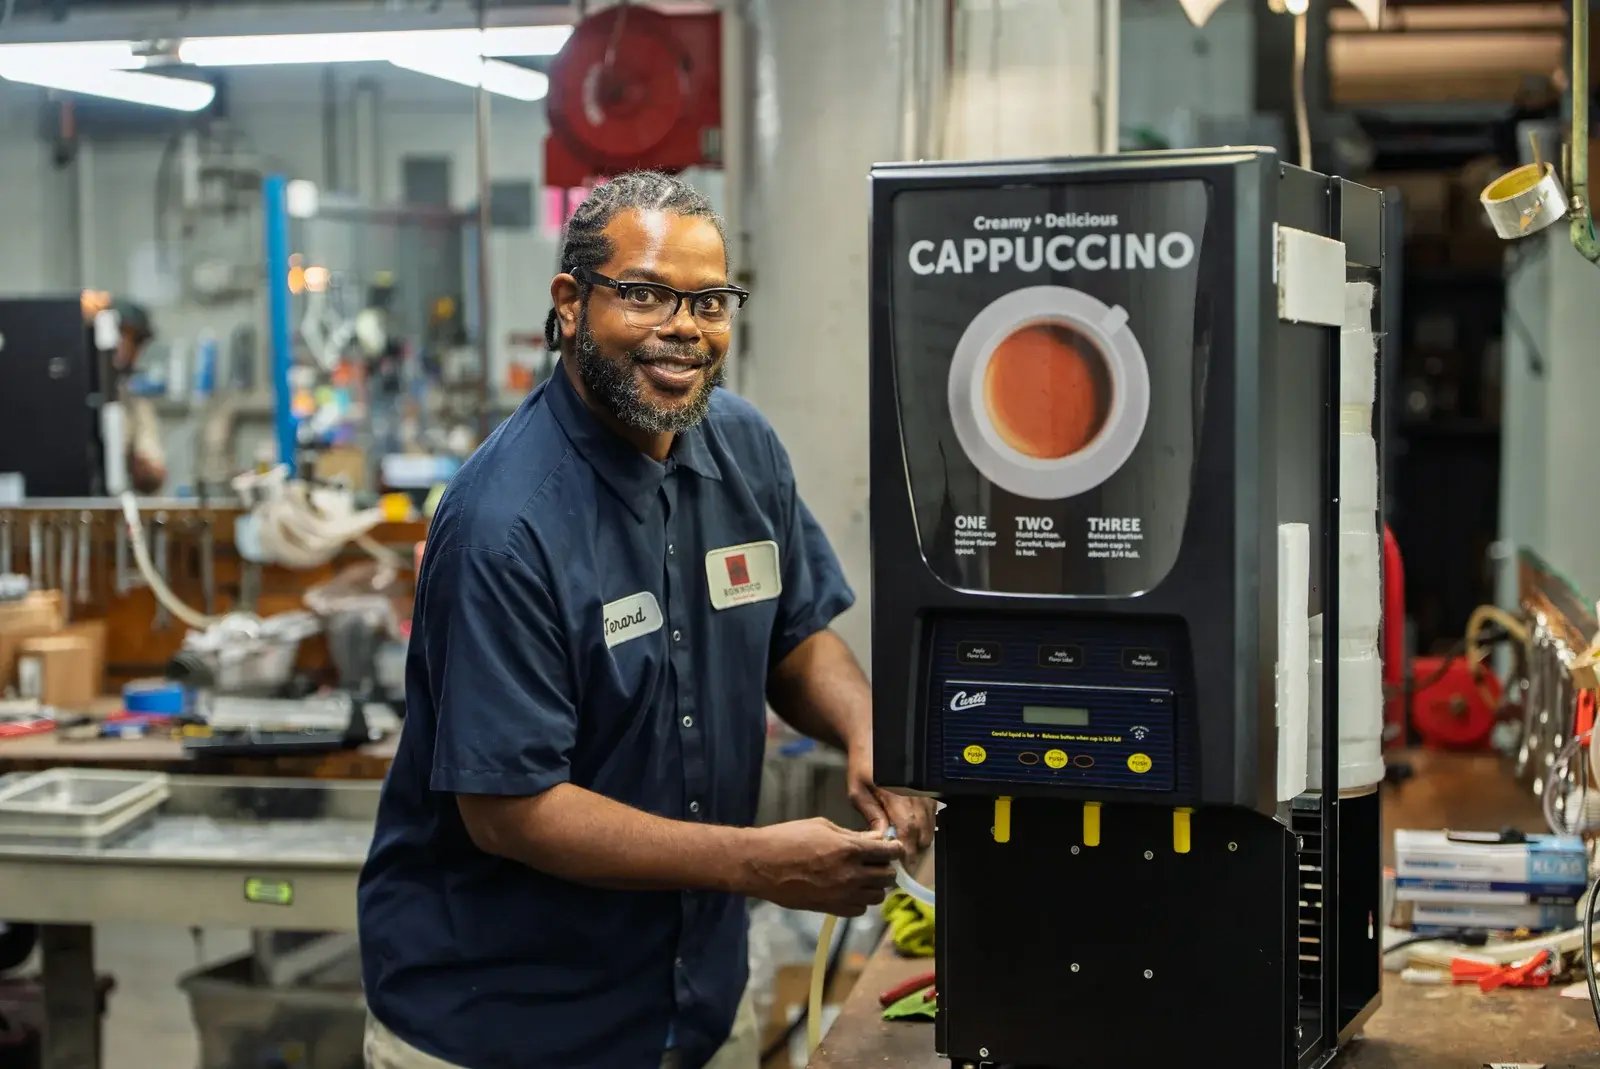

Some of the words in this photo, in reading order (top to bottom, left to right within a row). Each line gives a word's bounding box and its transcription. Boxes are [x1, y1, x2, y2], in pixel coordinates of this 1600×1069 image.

[973, 215, 1032, 232] Creamy
[1045, 212, 1119, 229] Delicious
[908, 231, 1195, 275] CAPPUCCINO
[954, 515, 988, 530] ONE
[1015, 516, 1054, 531] TWO
[1087, 517, 1141, 532] THREE
[955, 530, 982, 538] Position
[983, 531, 997, 539] cup
[1015, 531, 1033, 539] Hold
[1088, 532, 1116, 540] Release
[1045, 541, 1066, 549] liquid
[1110, 543, 1124, 551] cup
[1009, 731, 1021, 739] liquid
